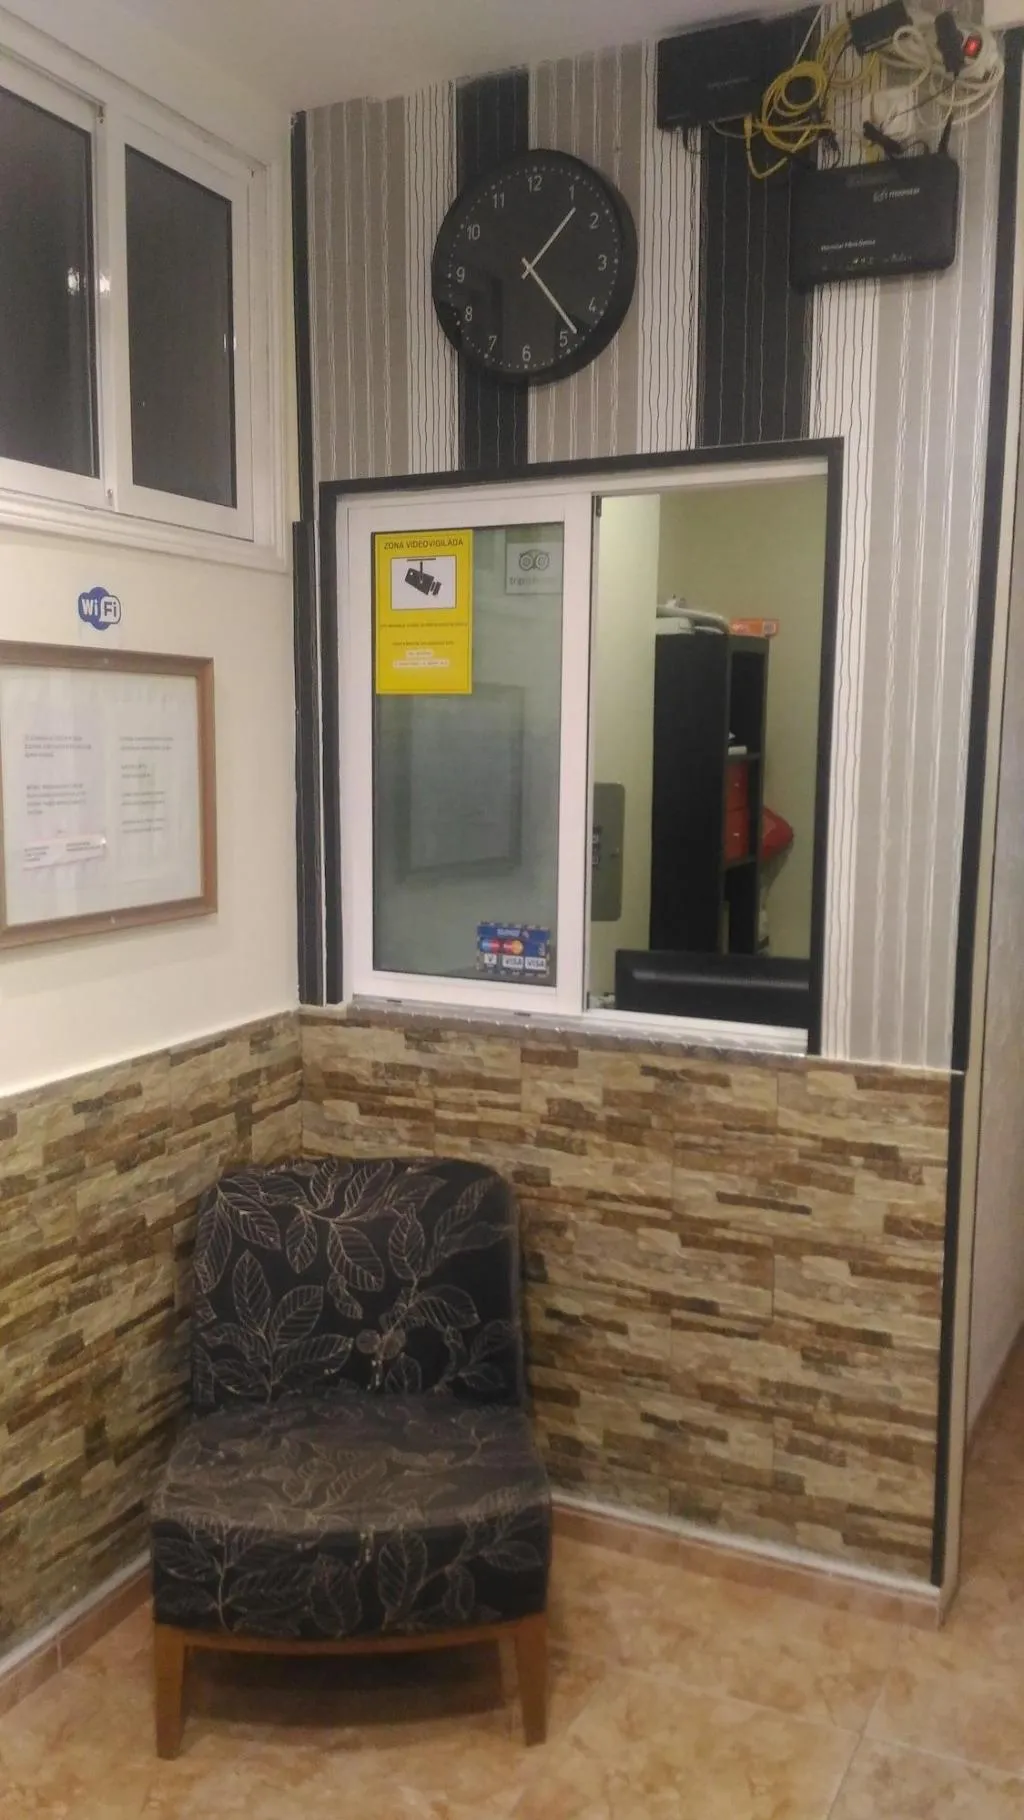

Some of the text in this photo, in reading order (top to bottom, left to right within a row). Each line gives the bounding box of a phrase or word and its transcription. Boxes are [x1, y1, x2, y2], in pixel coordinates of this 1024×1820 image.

[528, 175, 542, 192] 12
[569, 185, 575, 200] 1
[493, 193, 505, 209] 11
[589, 212, 599, 229] 2
[466, 224, 481, 241] 10
[598, 254, 608, 271] 3
[456, 266, 465, 282] 9
[588, 297, 597, 313] 4
[464, 306, 473, 322] 8
[488, 335, 497, 351] 7
[559, 331, 568, 347] 5
[522, 344, 532, 361] 6
[384, 537, 464, 551] ZONA VIDEOVIGILADA
